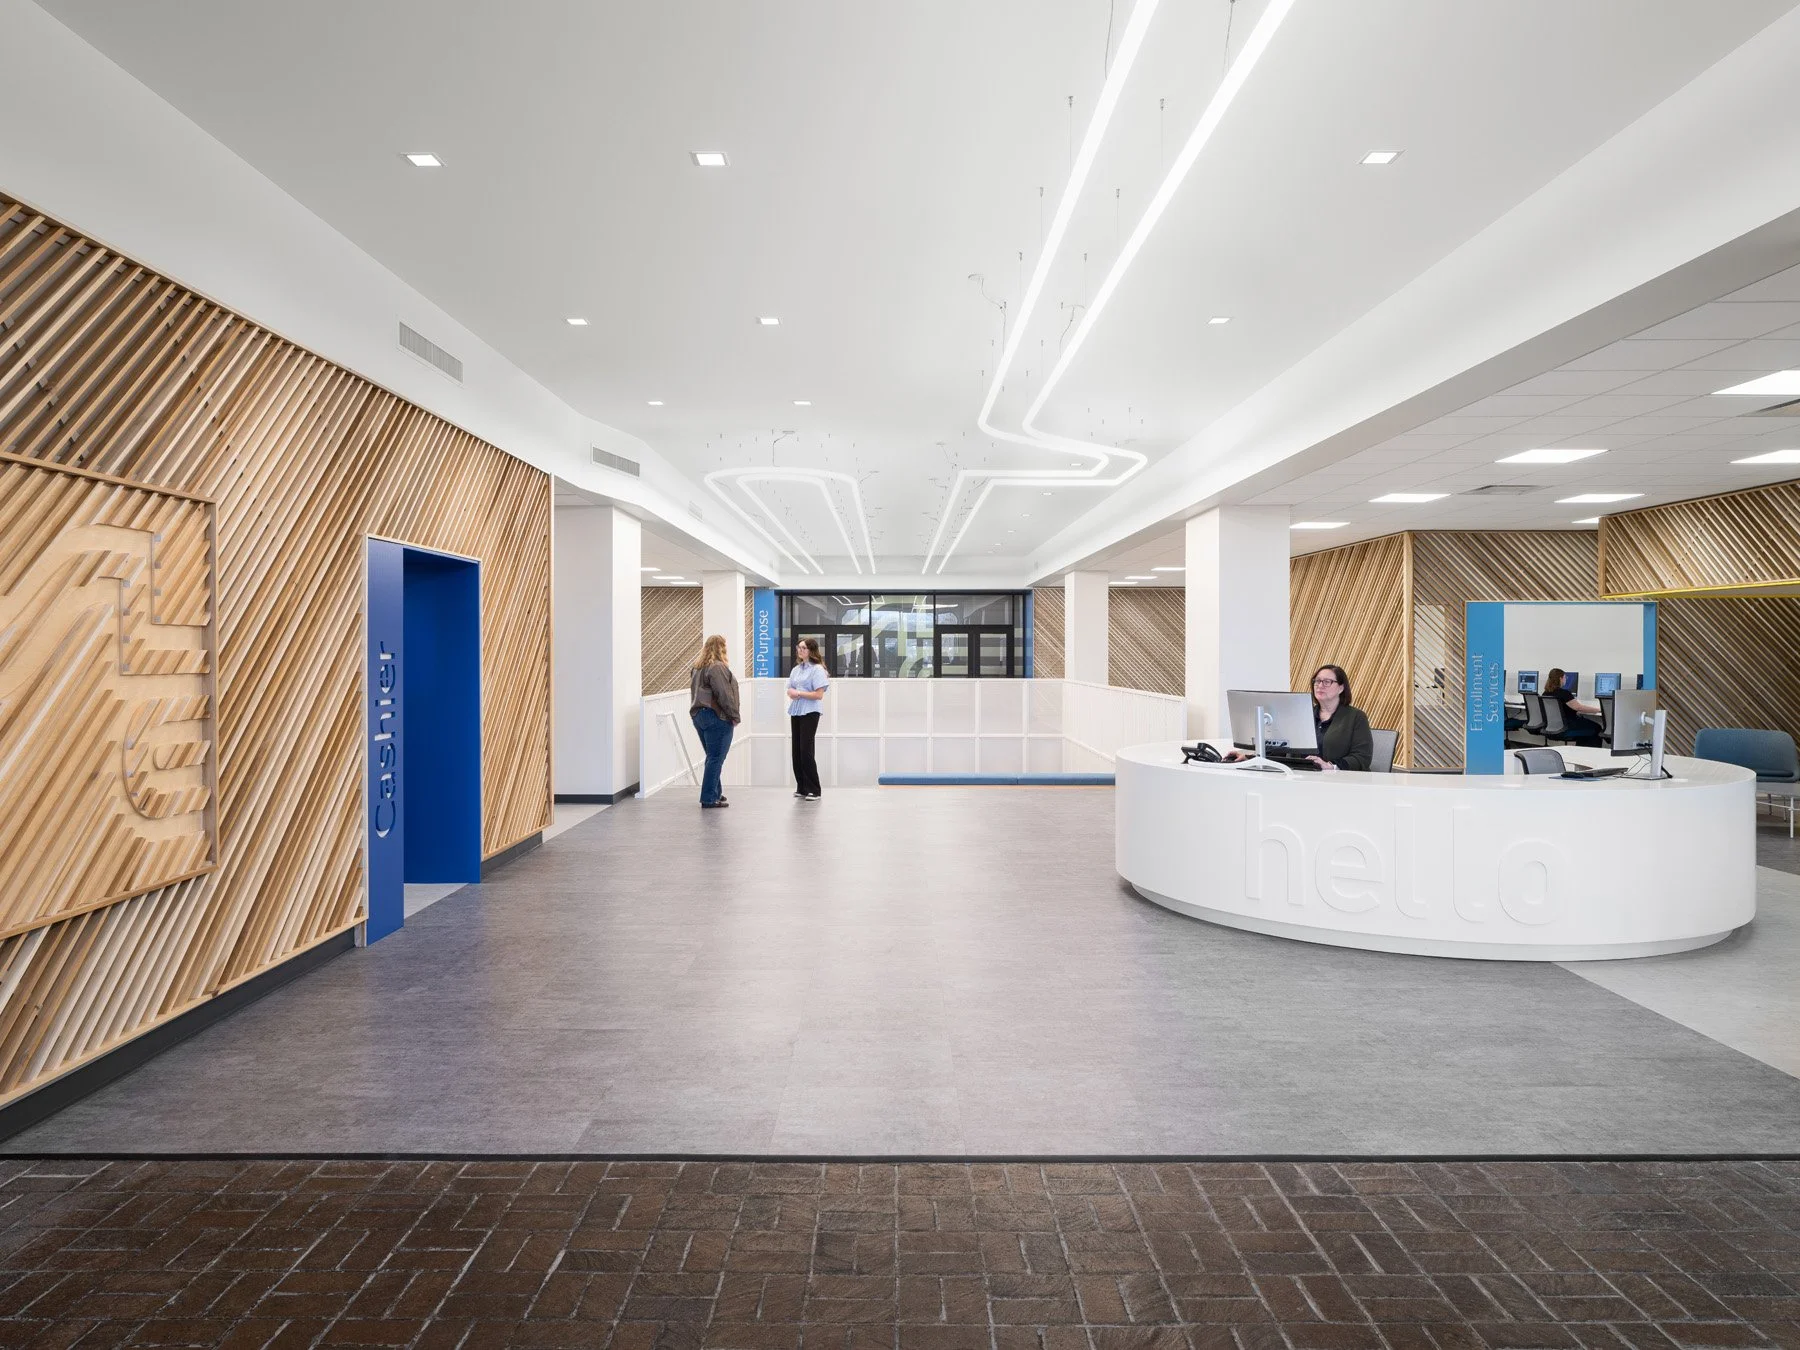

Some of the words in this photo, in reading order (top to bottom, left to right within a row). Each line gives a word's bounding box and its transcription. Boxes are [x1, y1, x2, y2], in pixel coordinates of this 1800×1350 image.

[756, 609, 770, 698] lti-Purpose
[1470, 655, 1483, 731] Enrollment
[1486, 662, 1499, 722] Services
[374, 640, 396, 838] Cashier
[1245, 792, 1569, 925] hello
